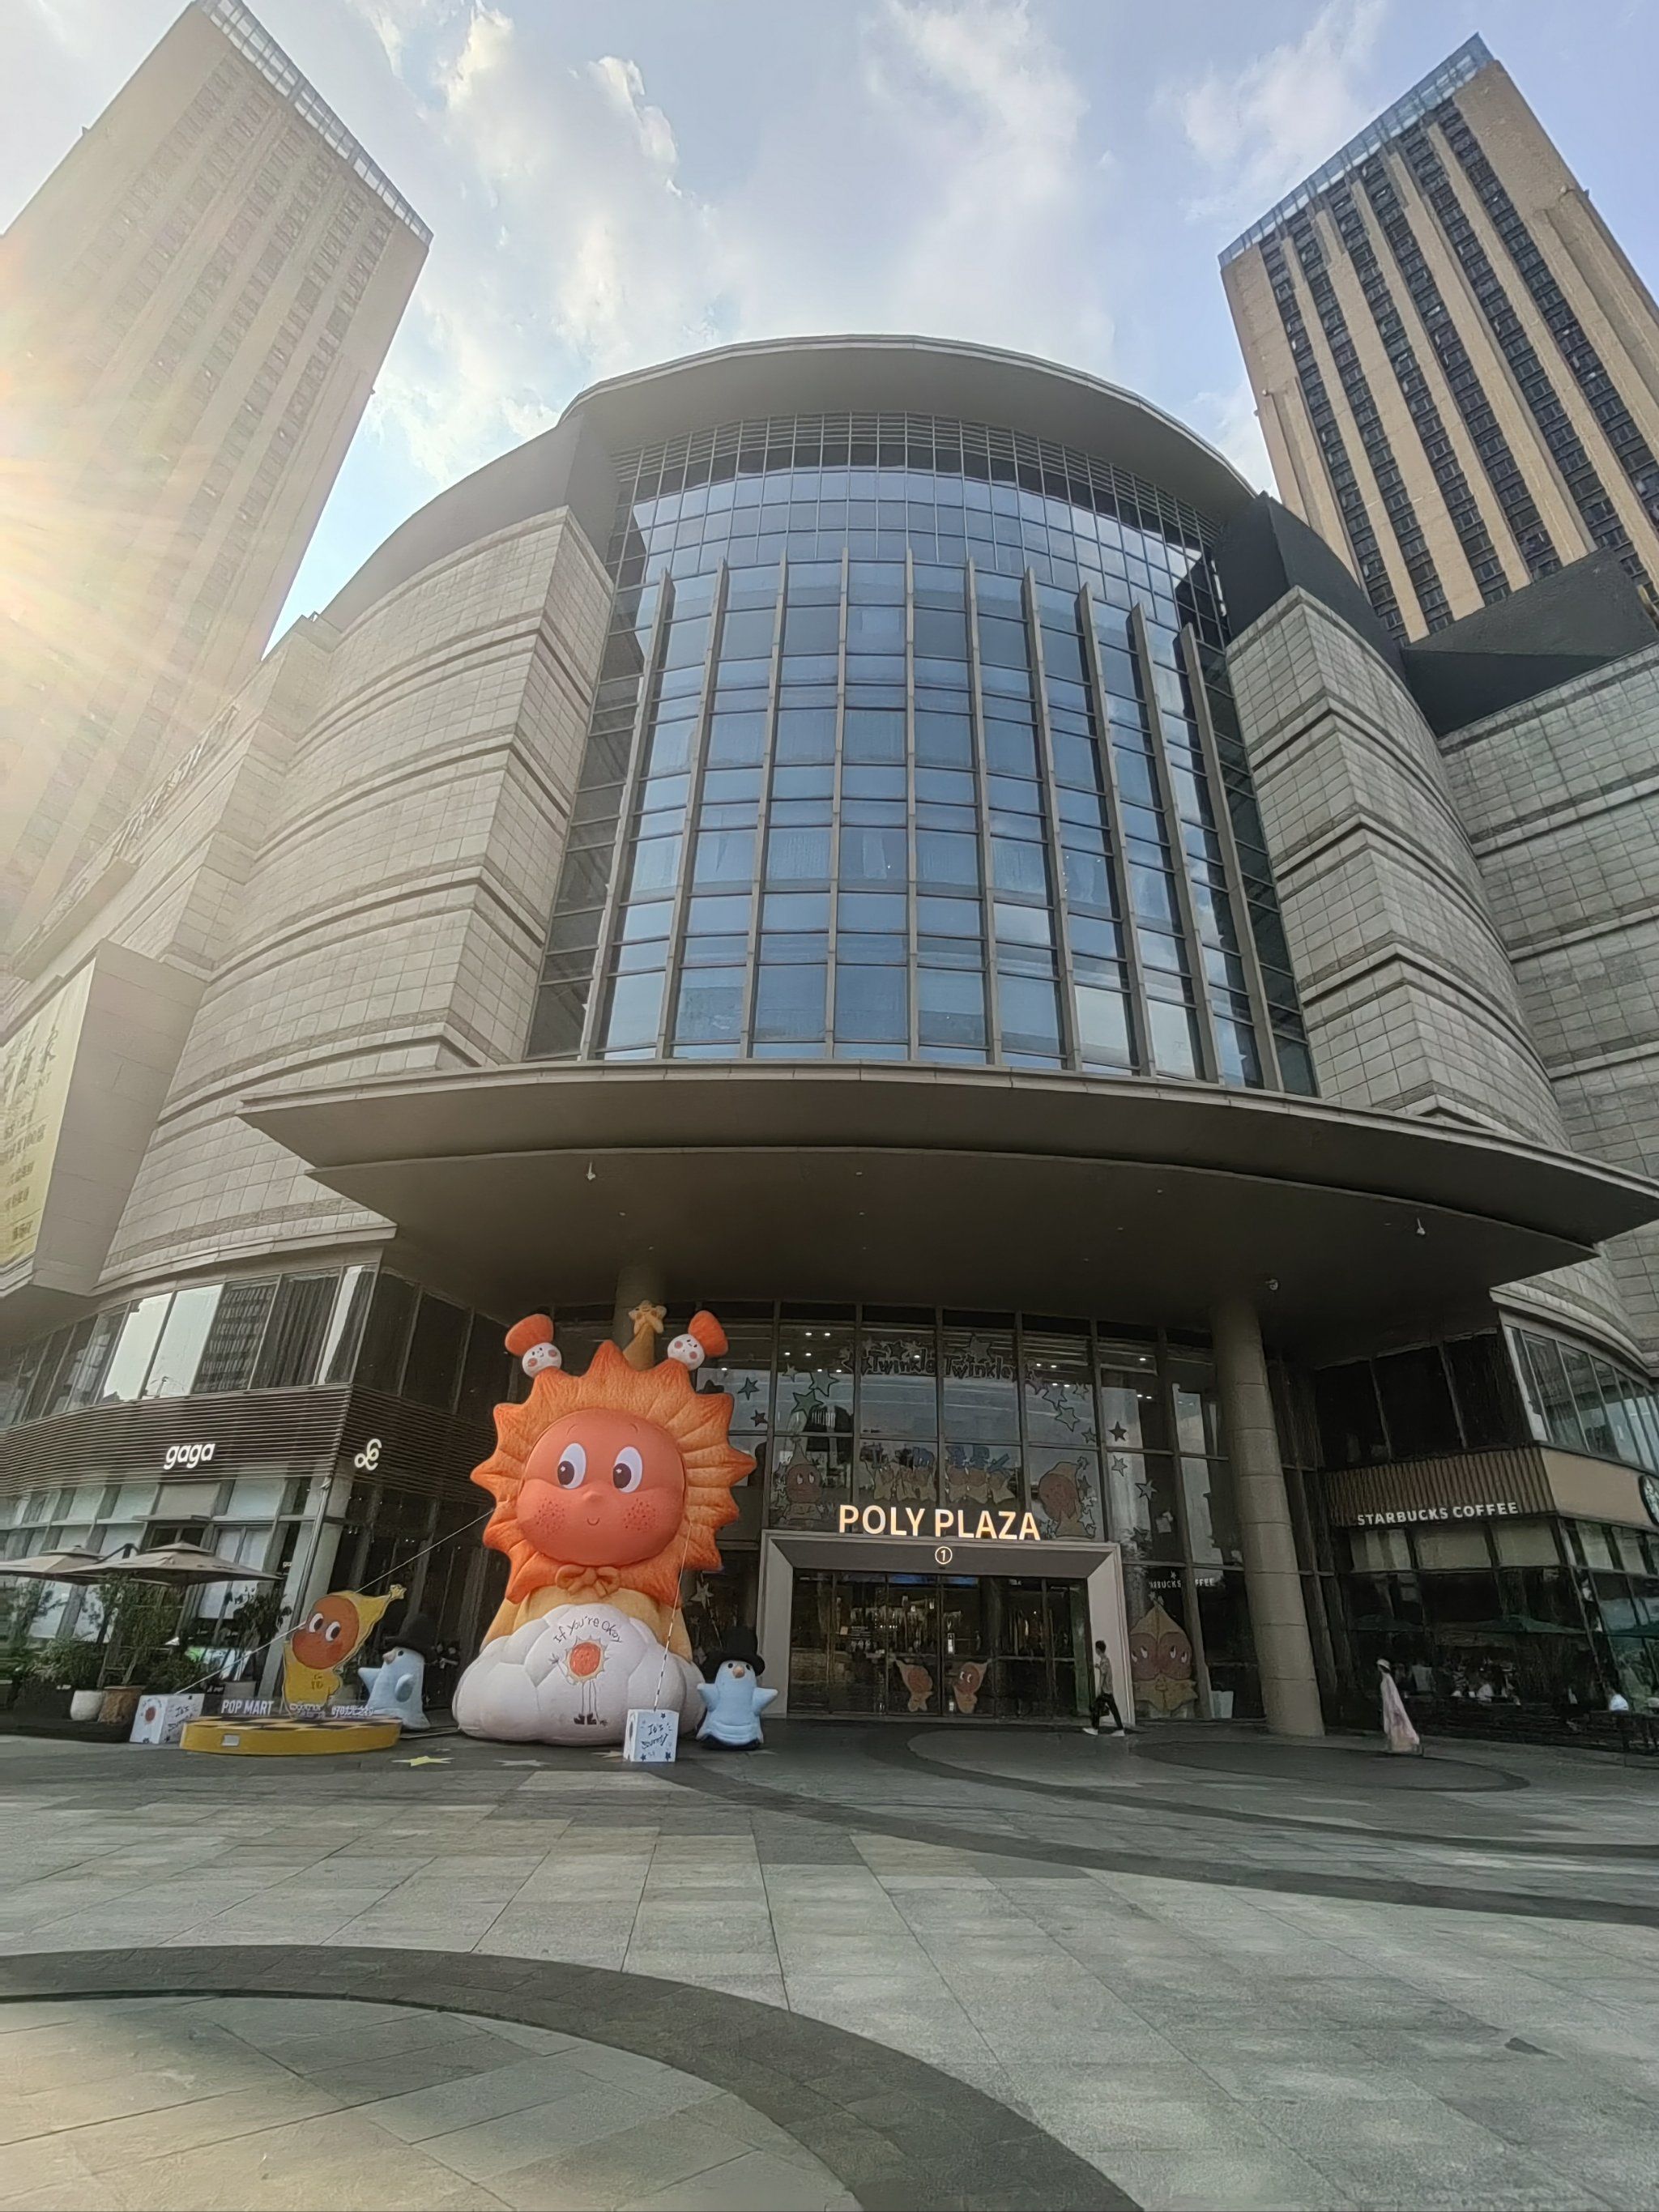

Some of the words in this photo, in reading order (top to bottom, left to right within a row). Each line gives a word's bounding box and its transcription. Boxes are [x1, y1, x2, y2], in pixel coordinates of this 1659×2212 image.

[163, 1443, 215, 1470] gaga
[839, 1504, 926, 1536] POLY
[935, 1509, 1041, 1541] PLAZA
[1357, 1507, 1449, 1526] STARBUCKS
[1452, 1502, 1519, 1519] COFFEE
[552, 1626, 567, 1644] If
[221, 1699, 242, 1715] POP
[244, 1700, 275, 1715] MART
